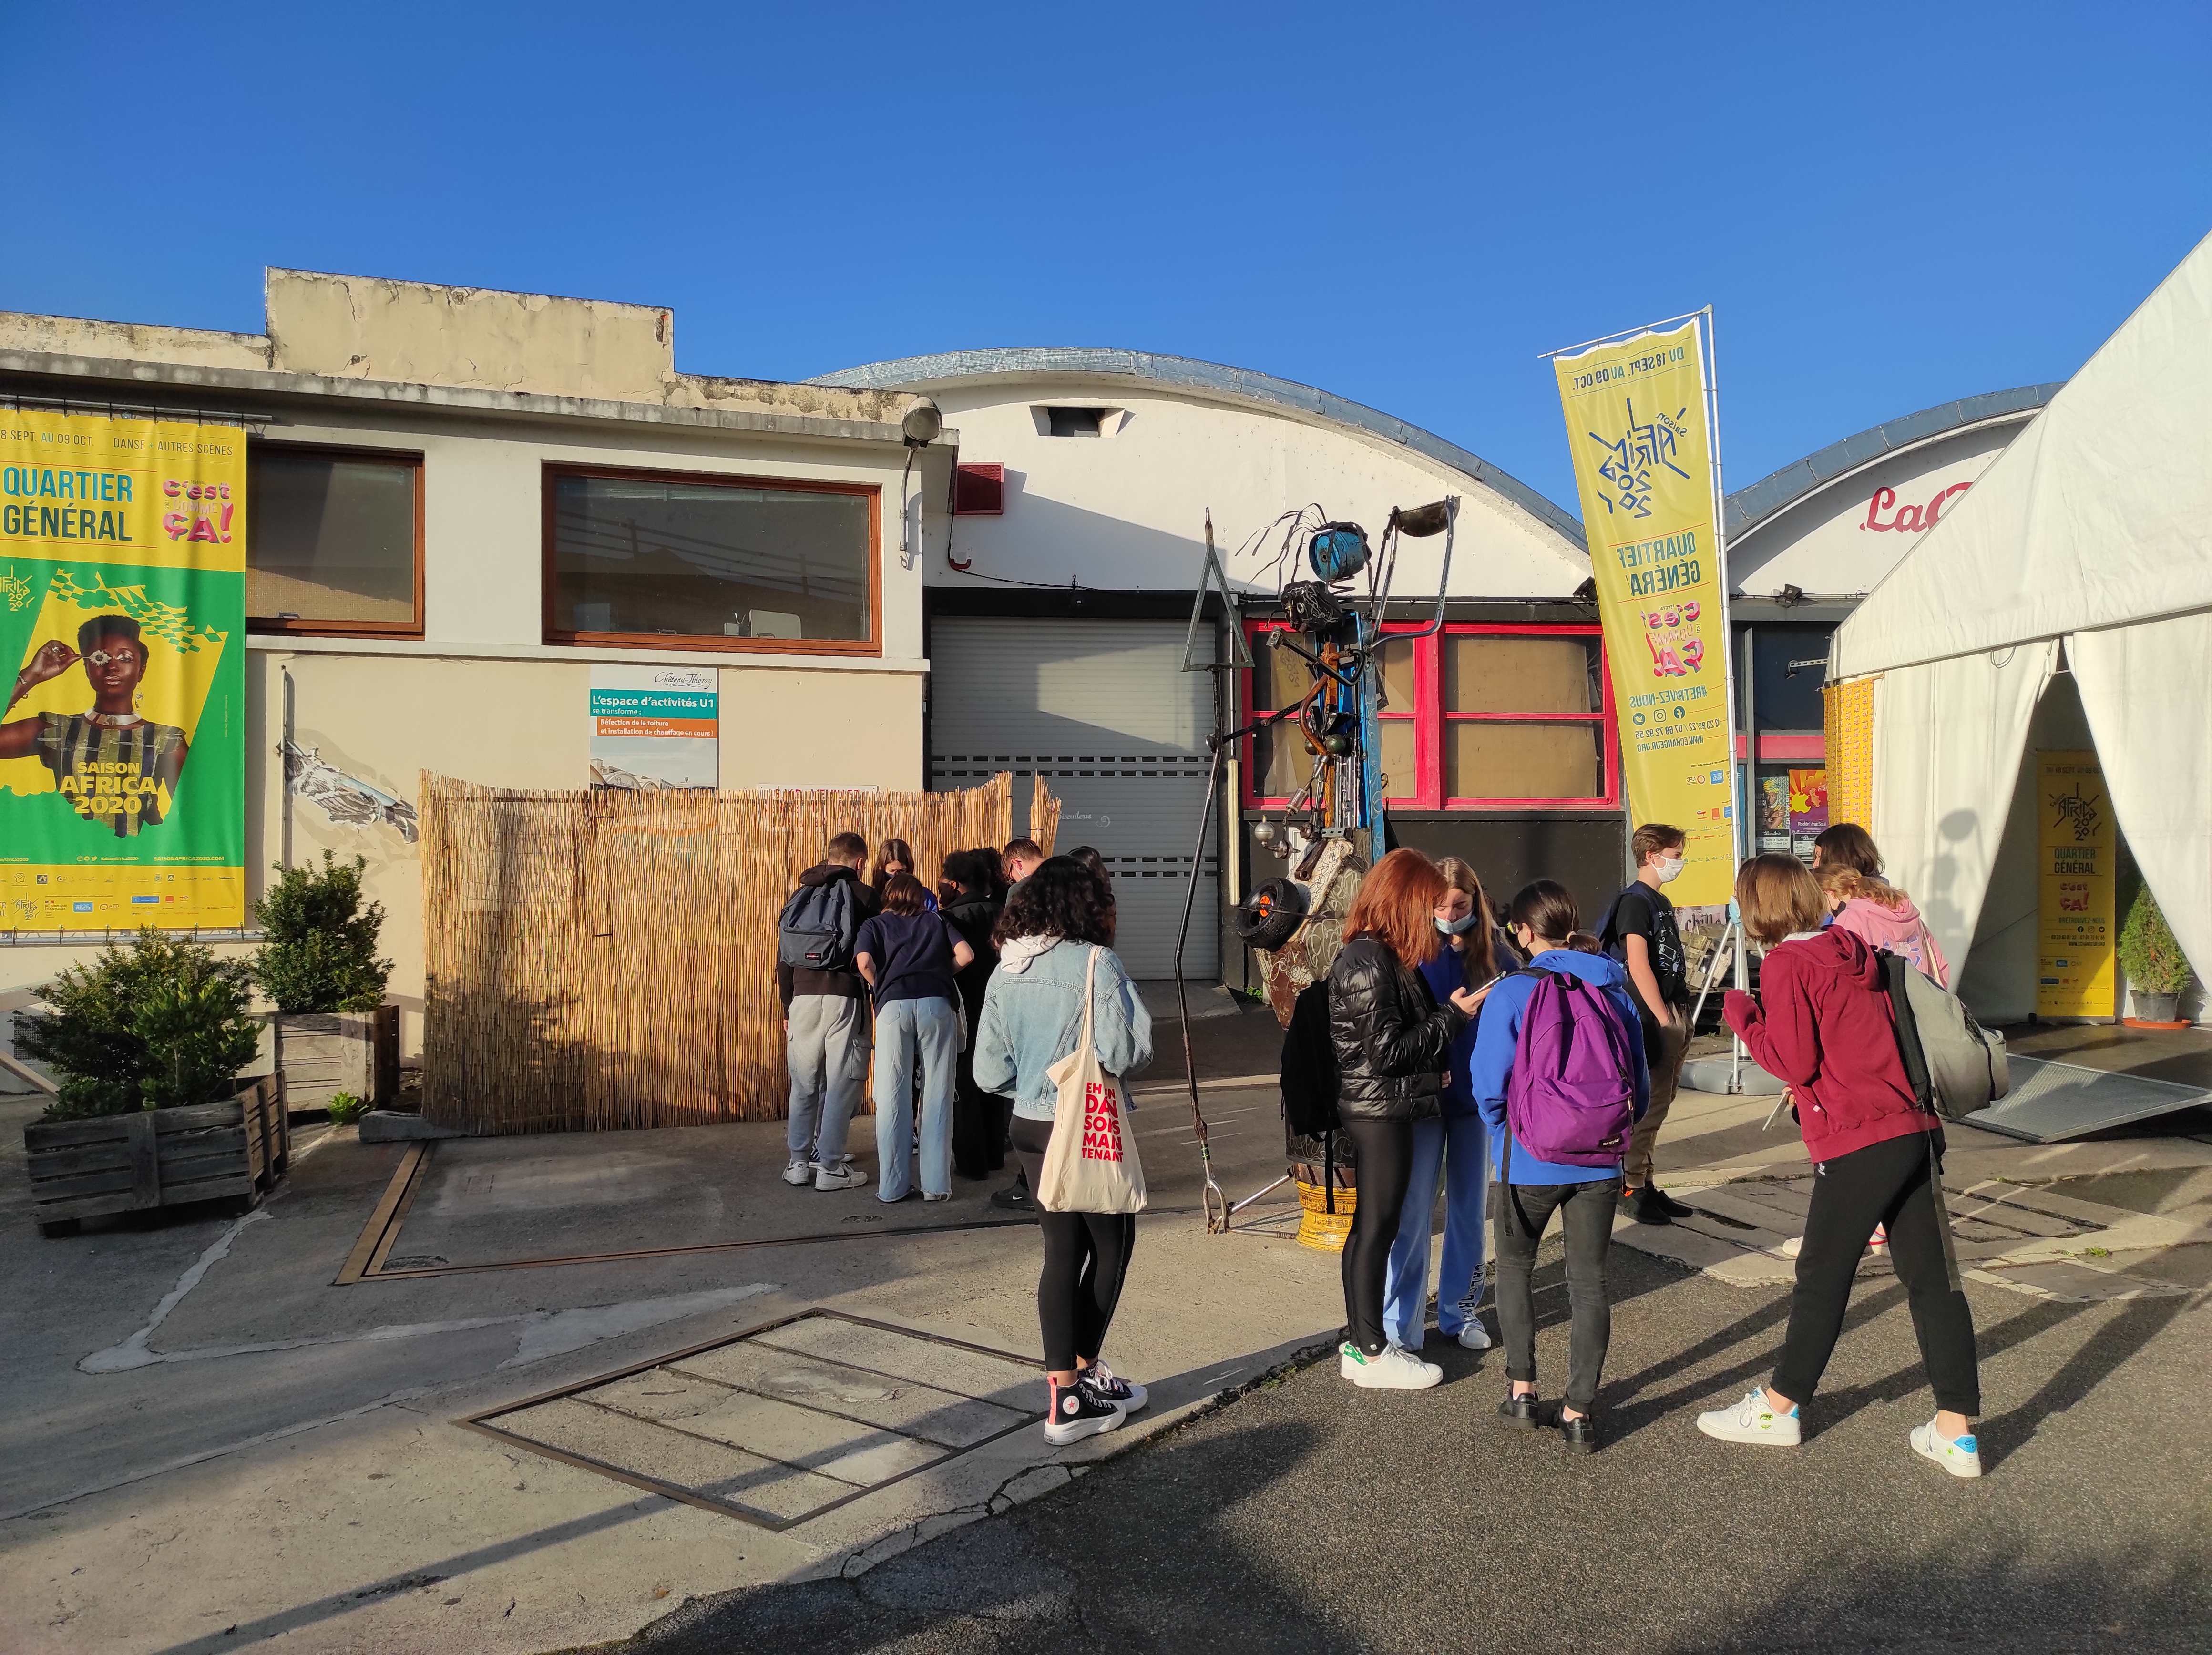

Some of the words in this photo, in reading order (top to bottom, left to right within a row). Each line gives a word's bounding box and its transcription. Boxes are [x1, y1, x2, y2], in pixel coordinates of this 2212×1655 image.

[10, 430, 37, 442] SEPT.
[41, 432, 54, 443] AU
[58, 434, 70, 444] 09
[73, 435, 94, 447] OCT.
[113, 438, 145, 450] DANSE
[157, 441, 194, 453] AUTRES
[197, 441, 233, 456] SCÈNES
[3, 467, 133, 503] QUARTIER
[163, 479, 231, 500] C'est
[173, 498, 218, 515] COMME
[3, 500, 133, 541] GÉNÉRAL
[593, 695, 638, 707] L'espace
[641, 696, 698, 707] d'activités
[700, 698, 714, 708] U1
[654, 728, 684, 737] chauffage
[77, 762, 140, 774] SAISON
[59, 776, 157, 794] AFRICA
[74, 796, 142, 814] 2020
[2054, 848, 2096, 859] QUARTIER
[2054, 860, 2096, 874] GÉNÉRAL
[1086, 1082, 1102, 1094] EH
[1085, 1094, 1118, 1118] DAN
[1082, 1147, 1124, 1163] TENANT
